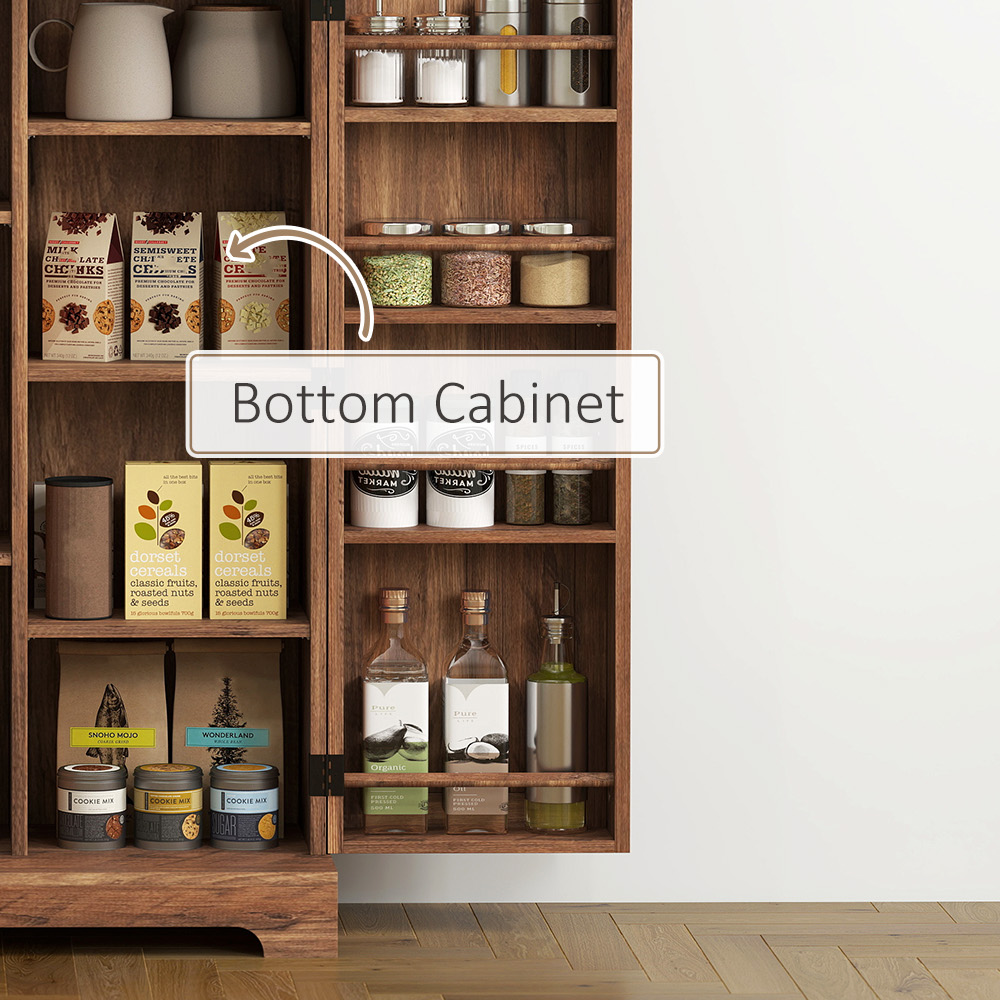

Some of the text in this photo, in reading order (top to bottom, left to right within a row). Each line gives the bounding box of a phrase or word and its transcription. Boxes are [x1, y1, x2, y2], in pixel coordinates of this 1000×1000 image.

[129, 550, 181, 563] dorset
[214, 550, 266, 563] dorset
[129, 564, 188, 577] cereals
[214, 564, 272, 577] cereals
[130, 579, 198, 588] classic fruits,
[214, 579, 283, 588] classic fruits,
[130, 589, 194, 597] roasted nuts
[215, 589, 279, 597] roasted nuts
[130, 598, 170, 607] & seeds
[214, 598, 254, 607] & seeds
[370, 764, 407, 772] Organic
[226, 797, 254, 805] COOKIE
[211, 812, 237, 836] SUGAR
